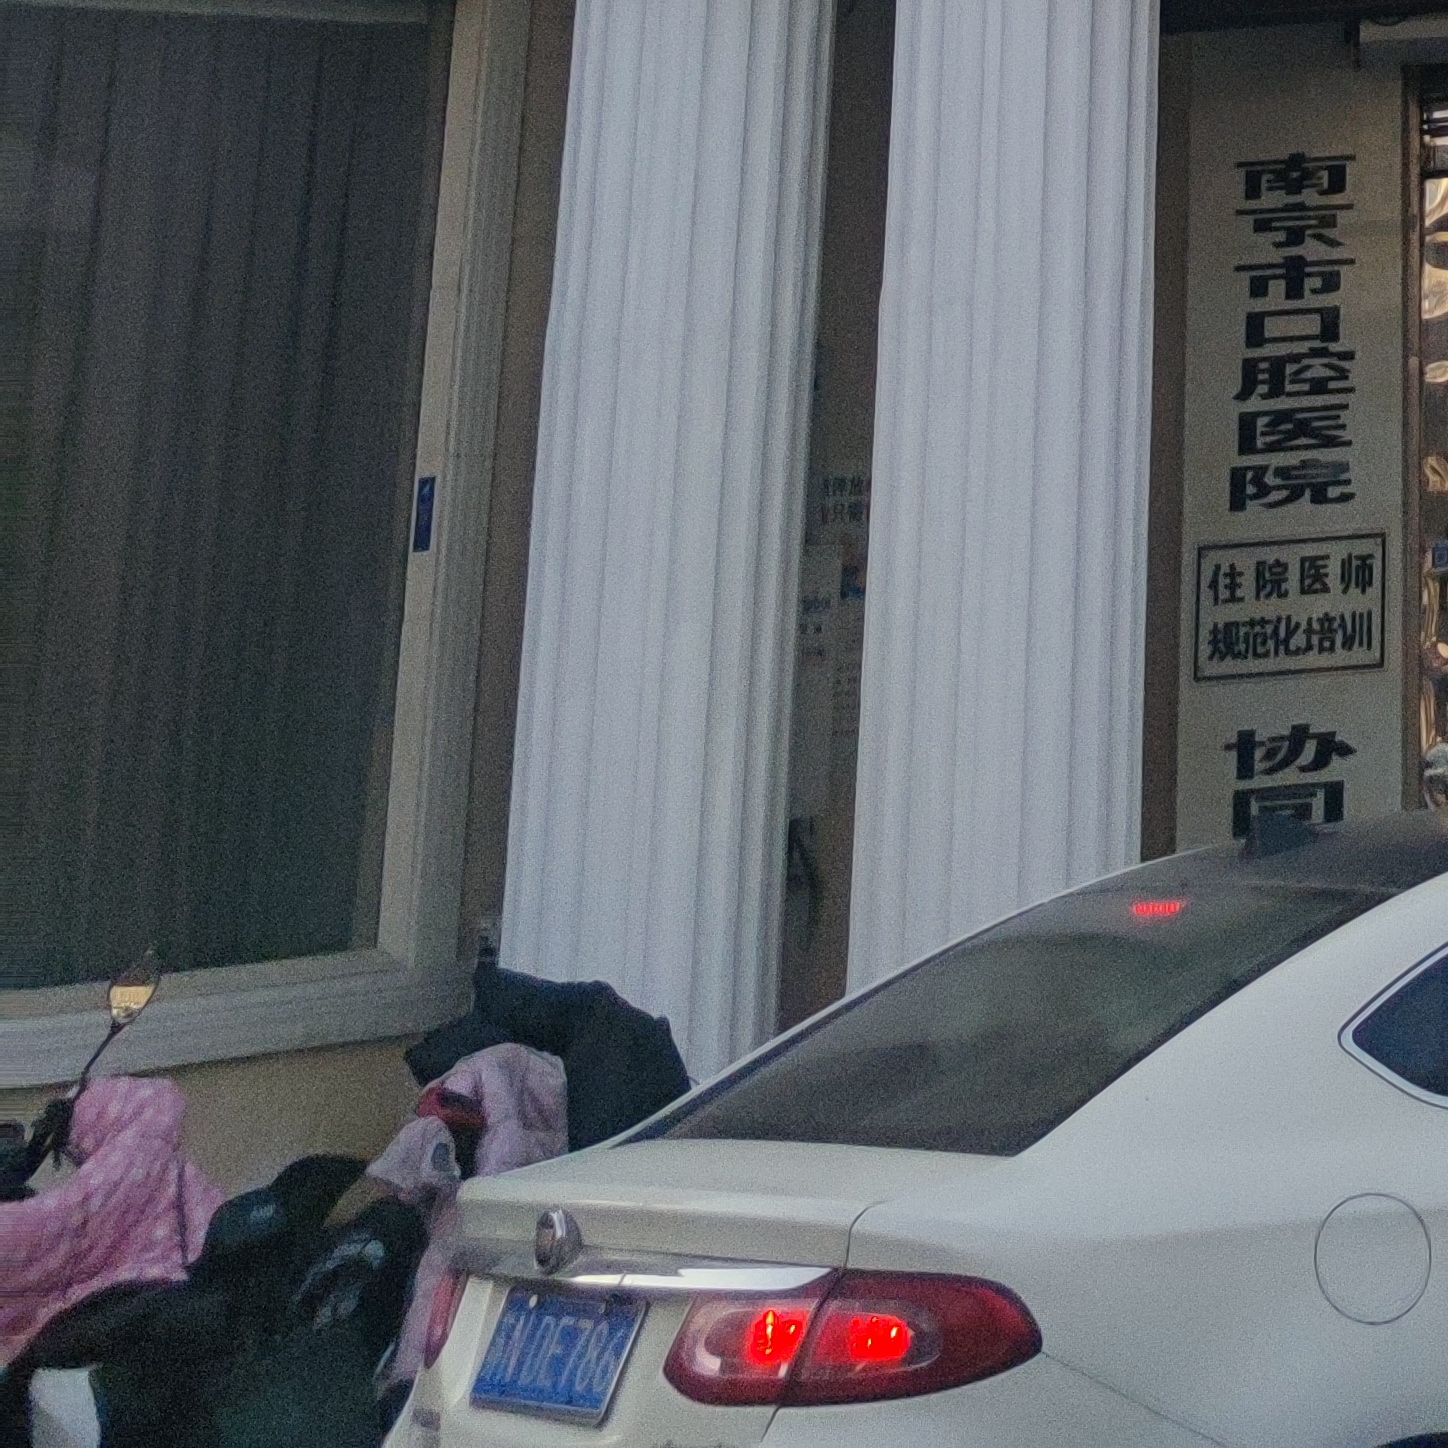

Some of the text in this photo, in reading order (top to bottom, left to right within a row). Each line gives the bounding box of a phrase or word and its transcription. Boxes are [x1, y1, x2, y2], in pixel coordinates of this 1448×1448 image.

[1230, 152, 1356, 511] 南京市口腔医院
[1207, 553, 1376, 607] 住院医师
[1207, 609, 1373, 662] 规范化培训
